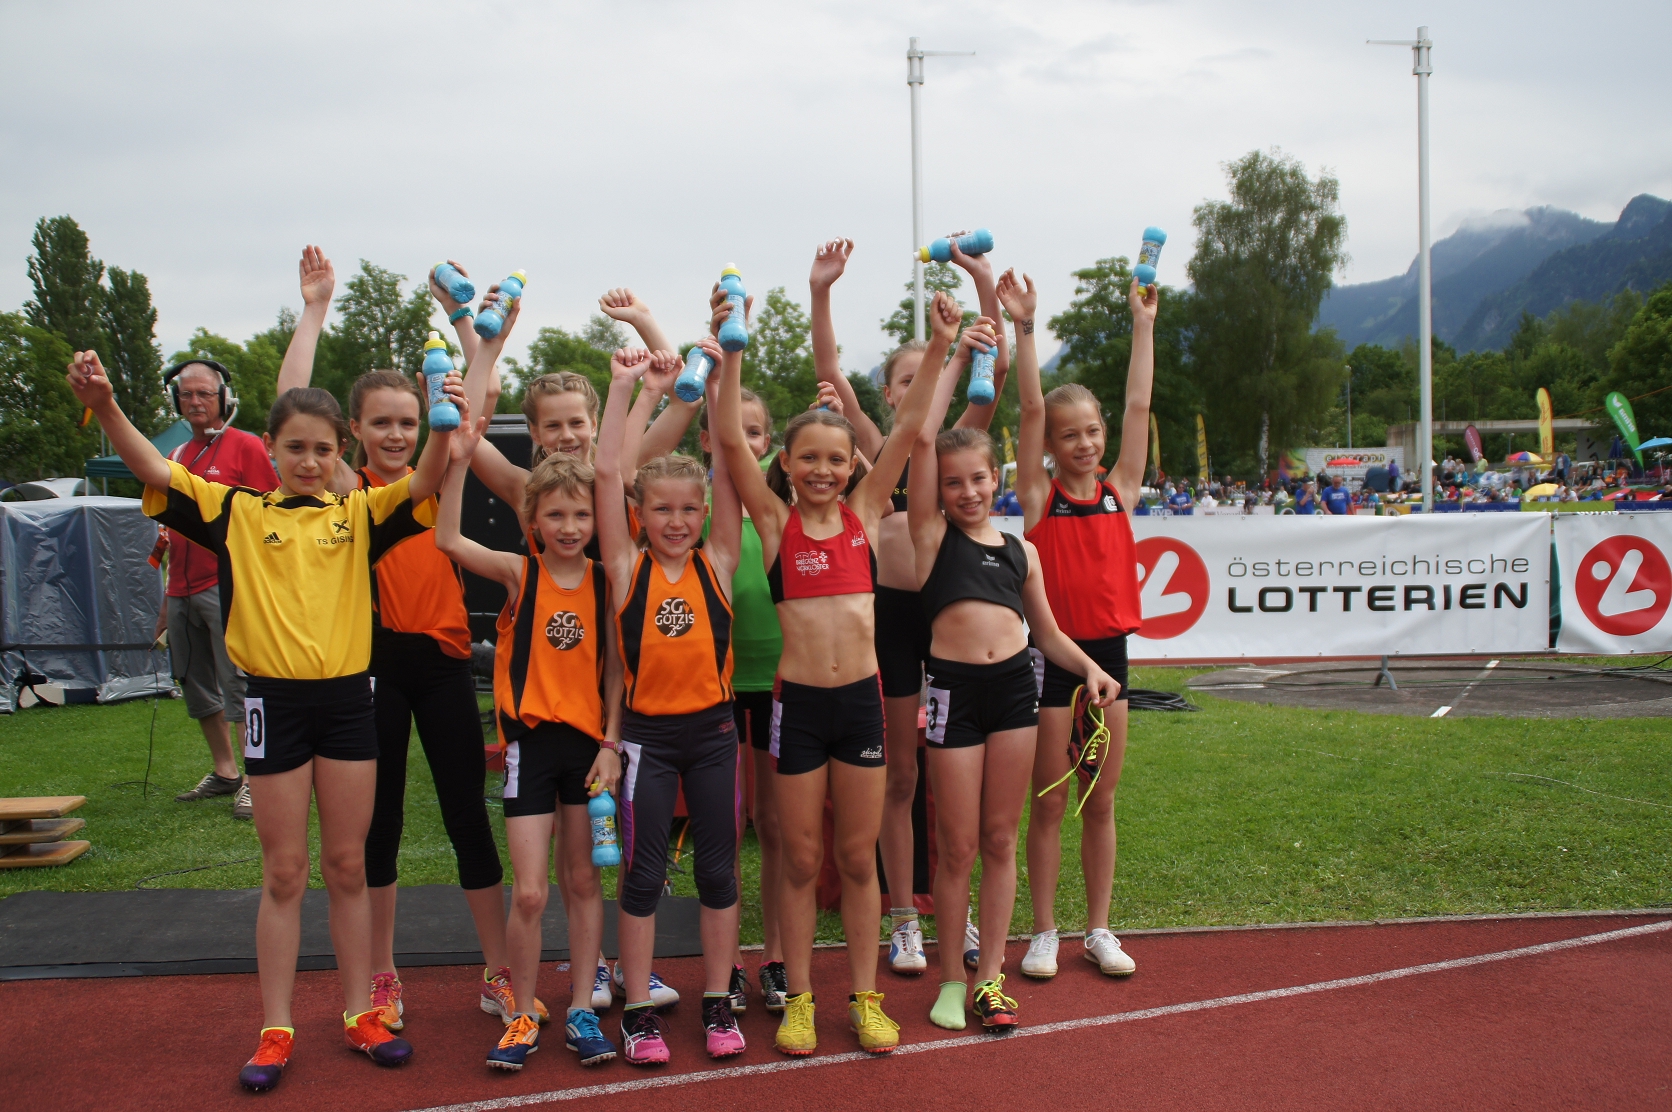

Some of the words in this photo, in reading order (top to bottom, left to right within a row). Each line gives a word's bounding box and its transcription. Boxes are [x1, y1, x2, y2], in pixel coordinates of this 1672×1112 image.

[316, 538, 329, 546] TS
[1227, 553, 1530, 578] österreichische
[1227, 581, 1530, 614] LOTTERIEN
[661, 598, 684, 615] SG
[551, 611, 577, 627] SG
